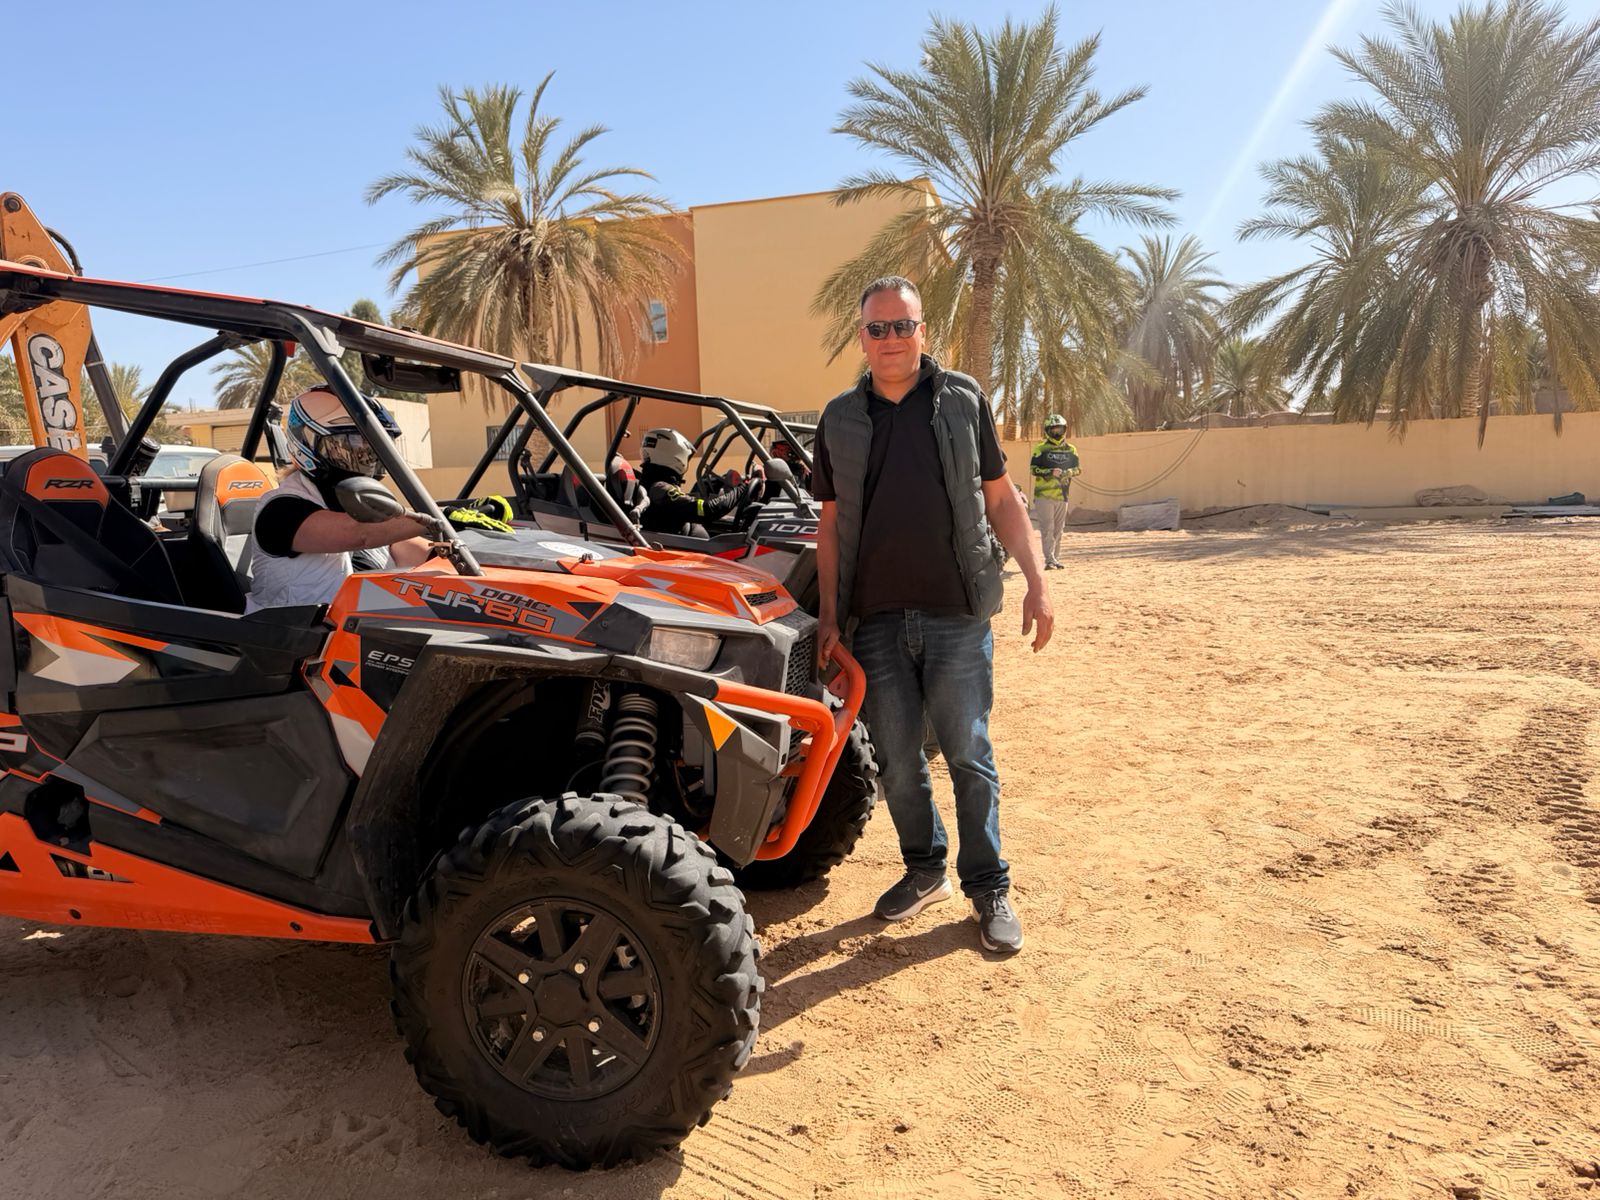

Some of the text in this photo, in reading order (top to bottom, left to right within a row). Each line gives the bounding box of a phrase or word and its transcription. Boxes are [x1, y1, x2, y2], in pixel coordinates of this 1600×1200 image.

[28, 333, 82, 451] CASE
[44, 478, 95, 490] RZR
[227, 480, 265, 491] RZR
[391, 577, 556, 633] TURBO
[481, 588, 552, 613] DOHC
[367, 650, 415, 668] EPS
